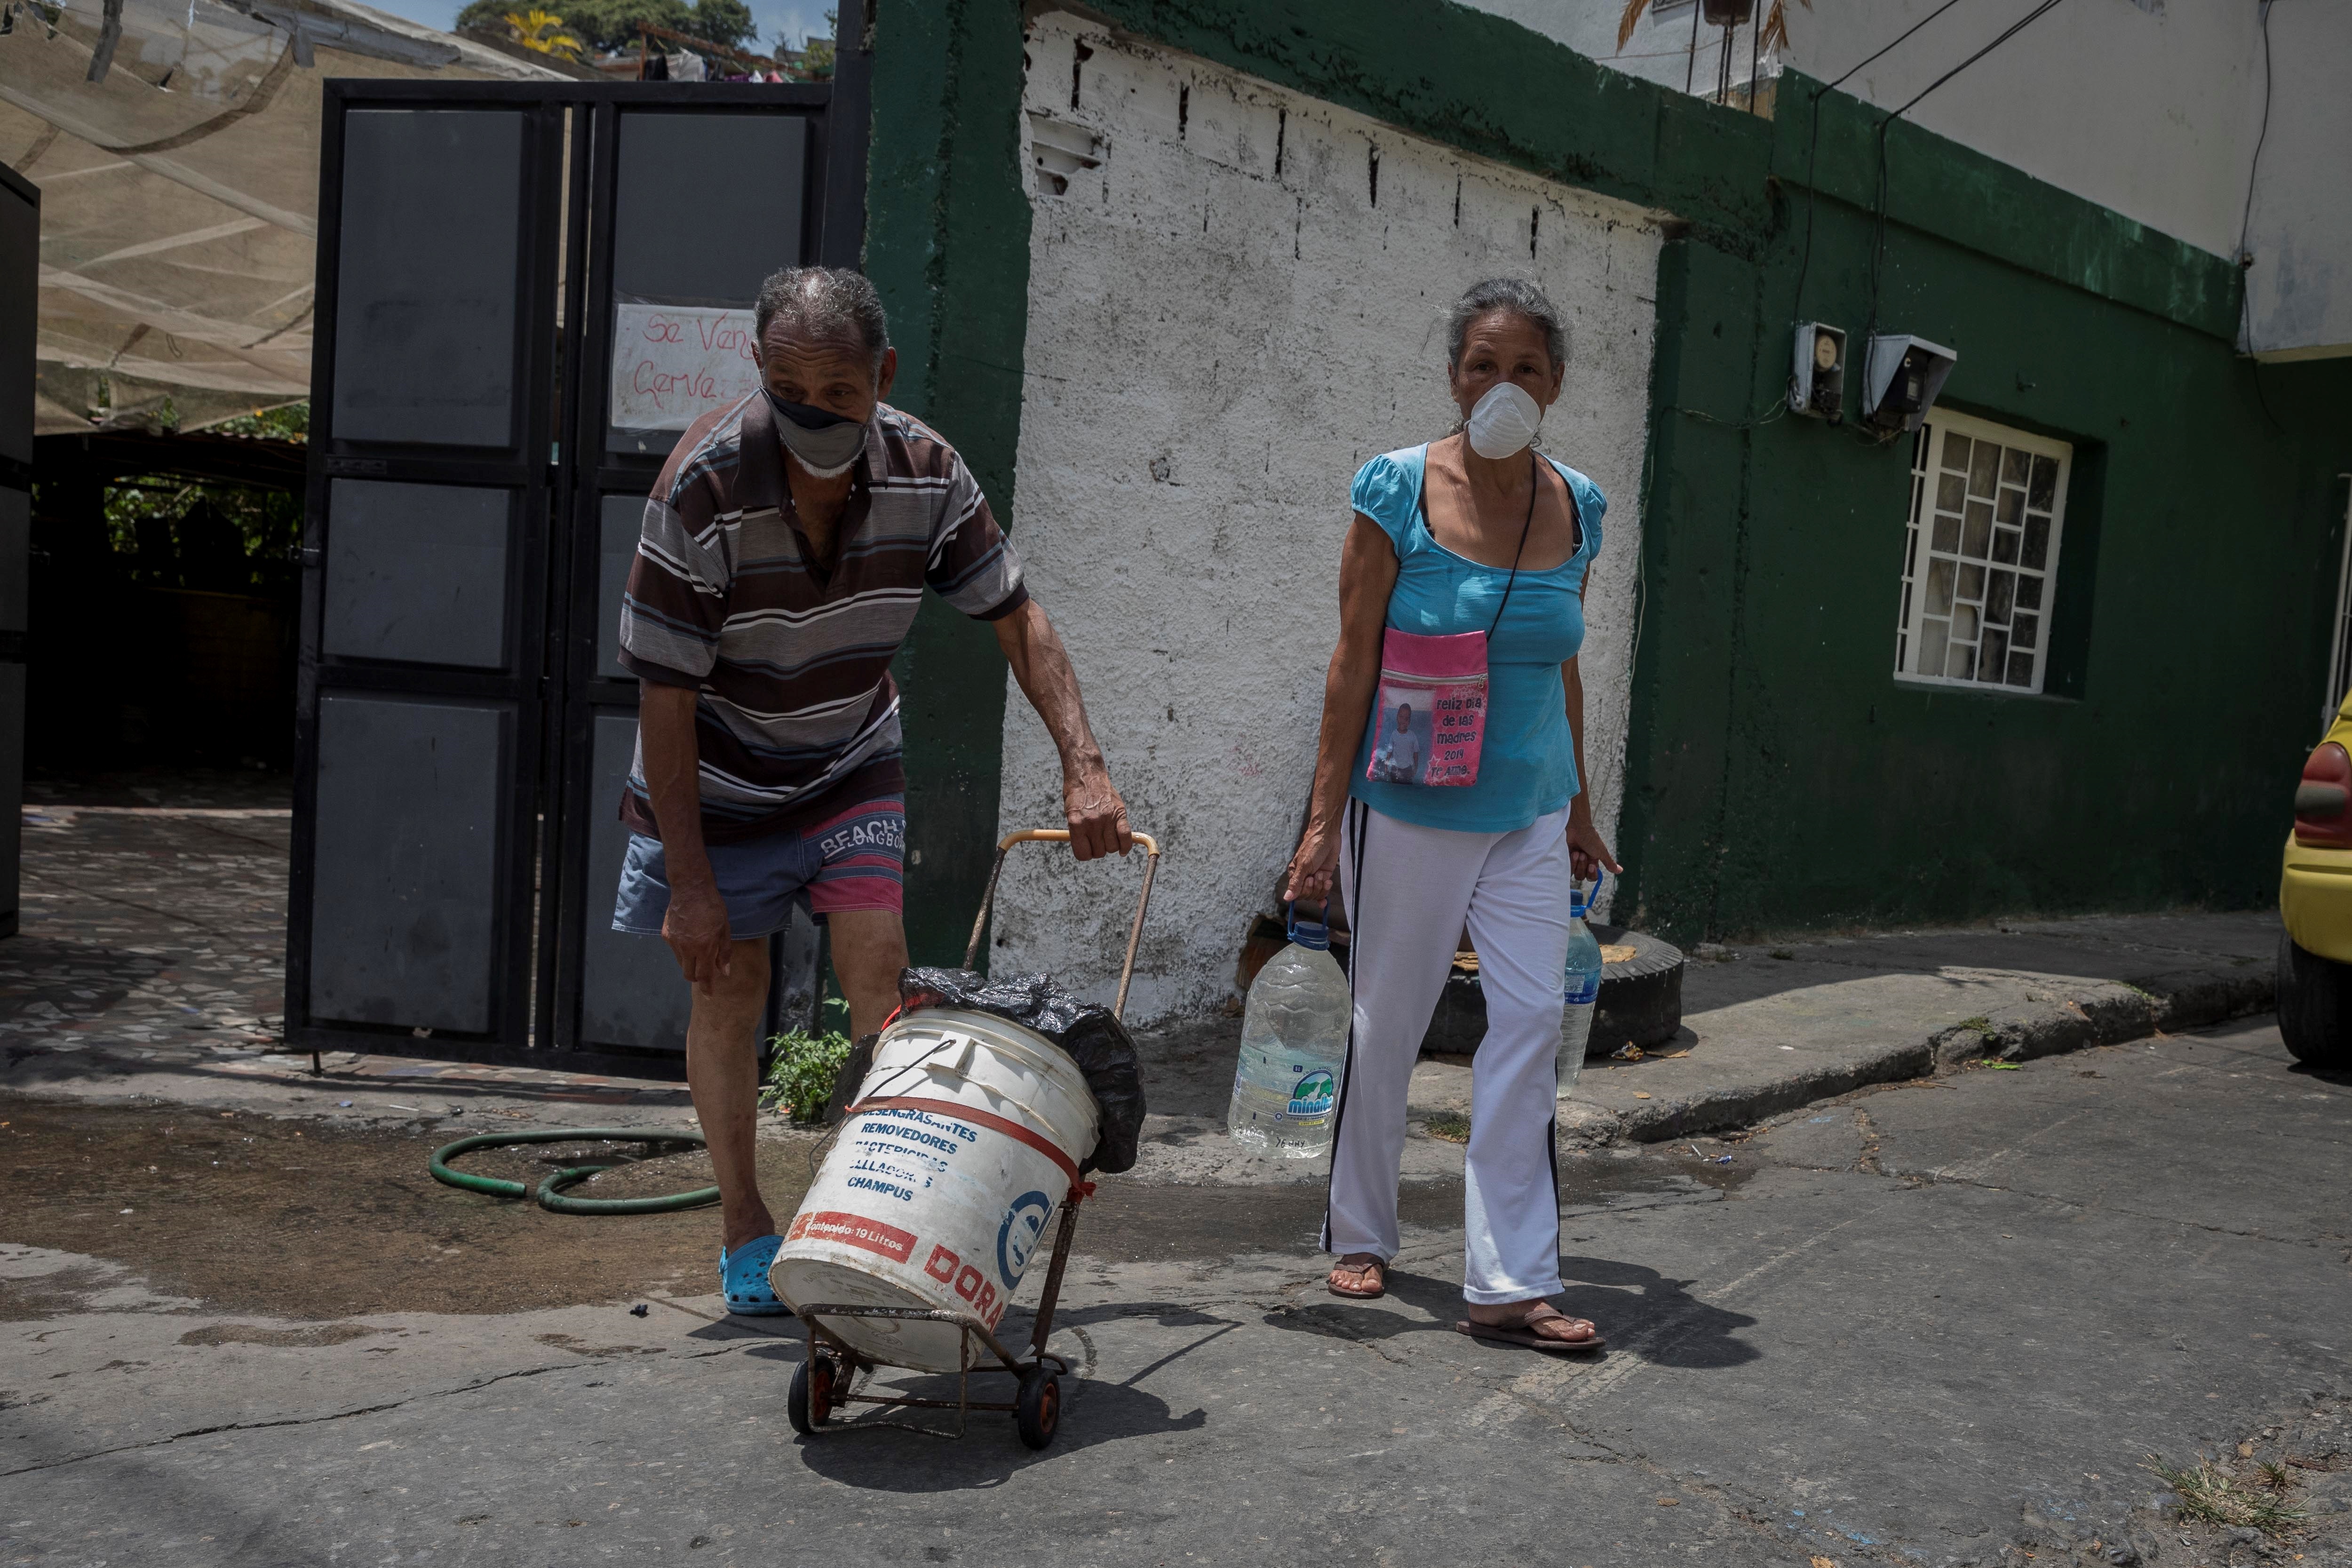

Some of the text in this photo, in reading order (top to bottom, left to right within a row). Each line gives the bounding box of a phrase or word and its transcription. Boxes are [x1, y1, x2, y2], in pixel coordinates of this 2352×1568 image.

[643, 311, 754, 360] Se Ven
[1436, 697, 1463, 710] Feliz
[1442, 714, 1475, 727] de las
[1437, 731, 1477, 745] madres
[1444, 748, 1464, 761] 2014
[861, 1123, 959, 1155] REMOVEDORES
[847, 1177, 914, 1202] CHAMPUS
[856, 1227, 868, 1238] 19
[867, 1230, 904, 1251] Litros
[923, 1243, 1003, 1333] DORA
